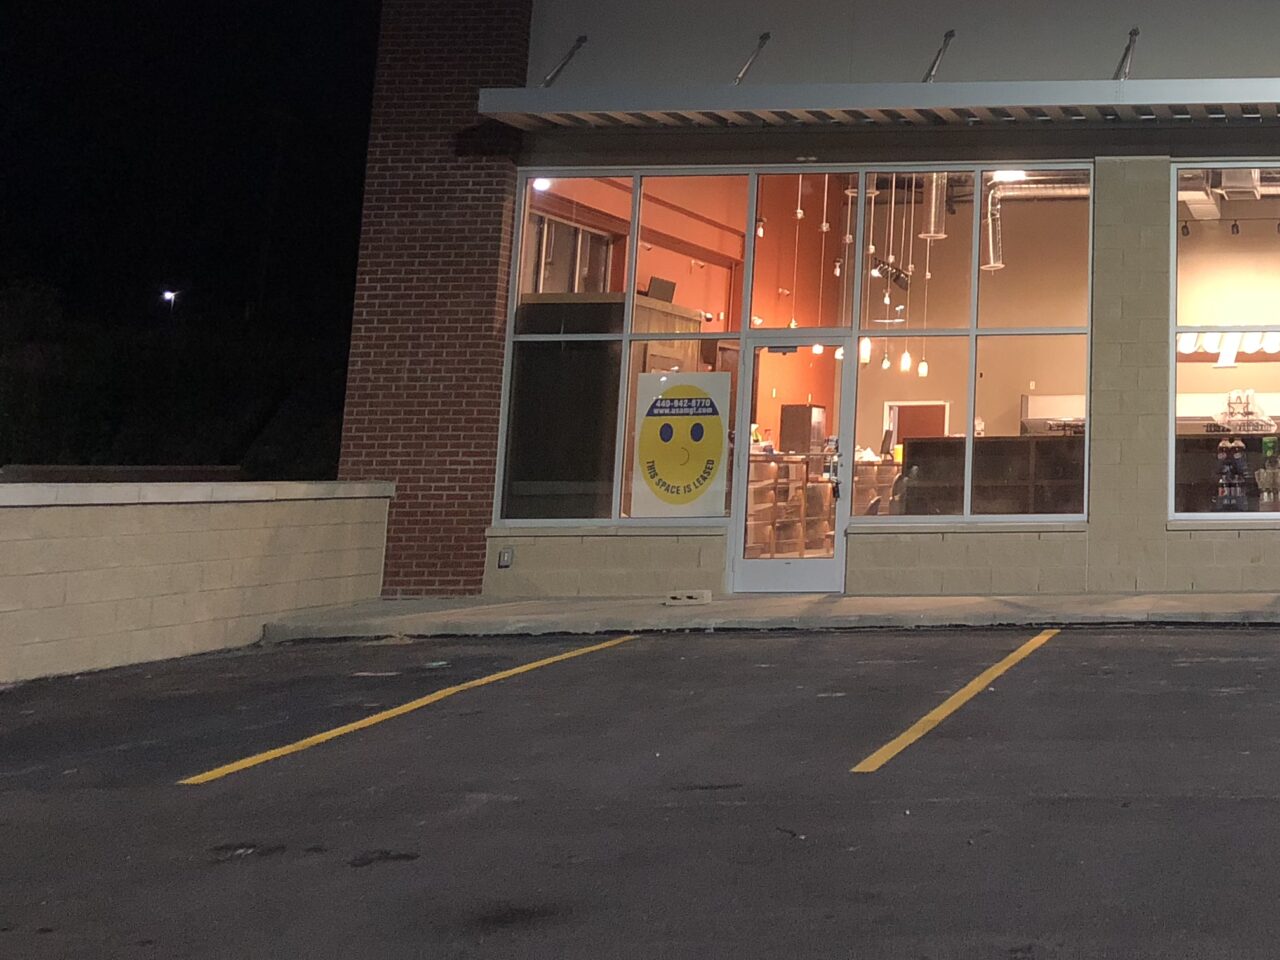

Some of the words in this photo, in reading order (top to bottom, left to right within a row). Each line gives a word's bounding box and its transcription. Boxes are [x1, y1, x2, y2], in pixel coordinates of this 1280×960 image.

[646, 460, 658, 480] THIS
[655, 478, 681, 495] SPACE
[683, 485, 692, 494] IS
[693, 459, 715, 488] LEASED
